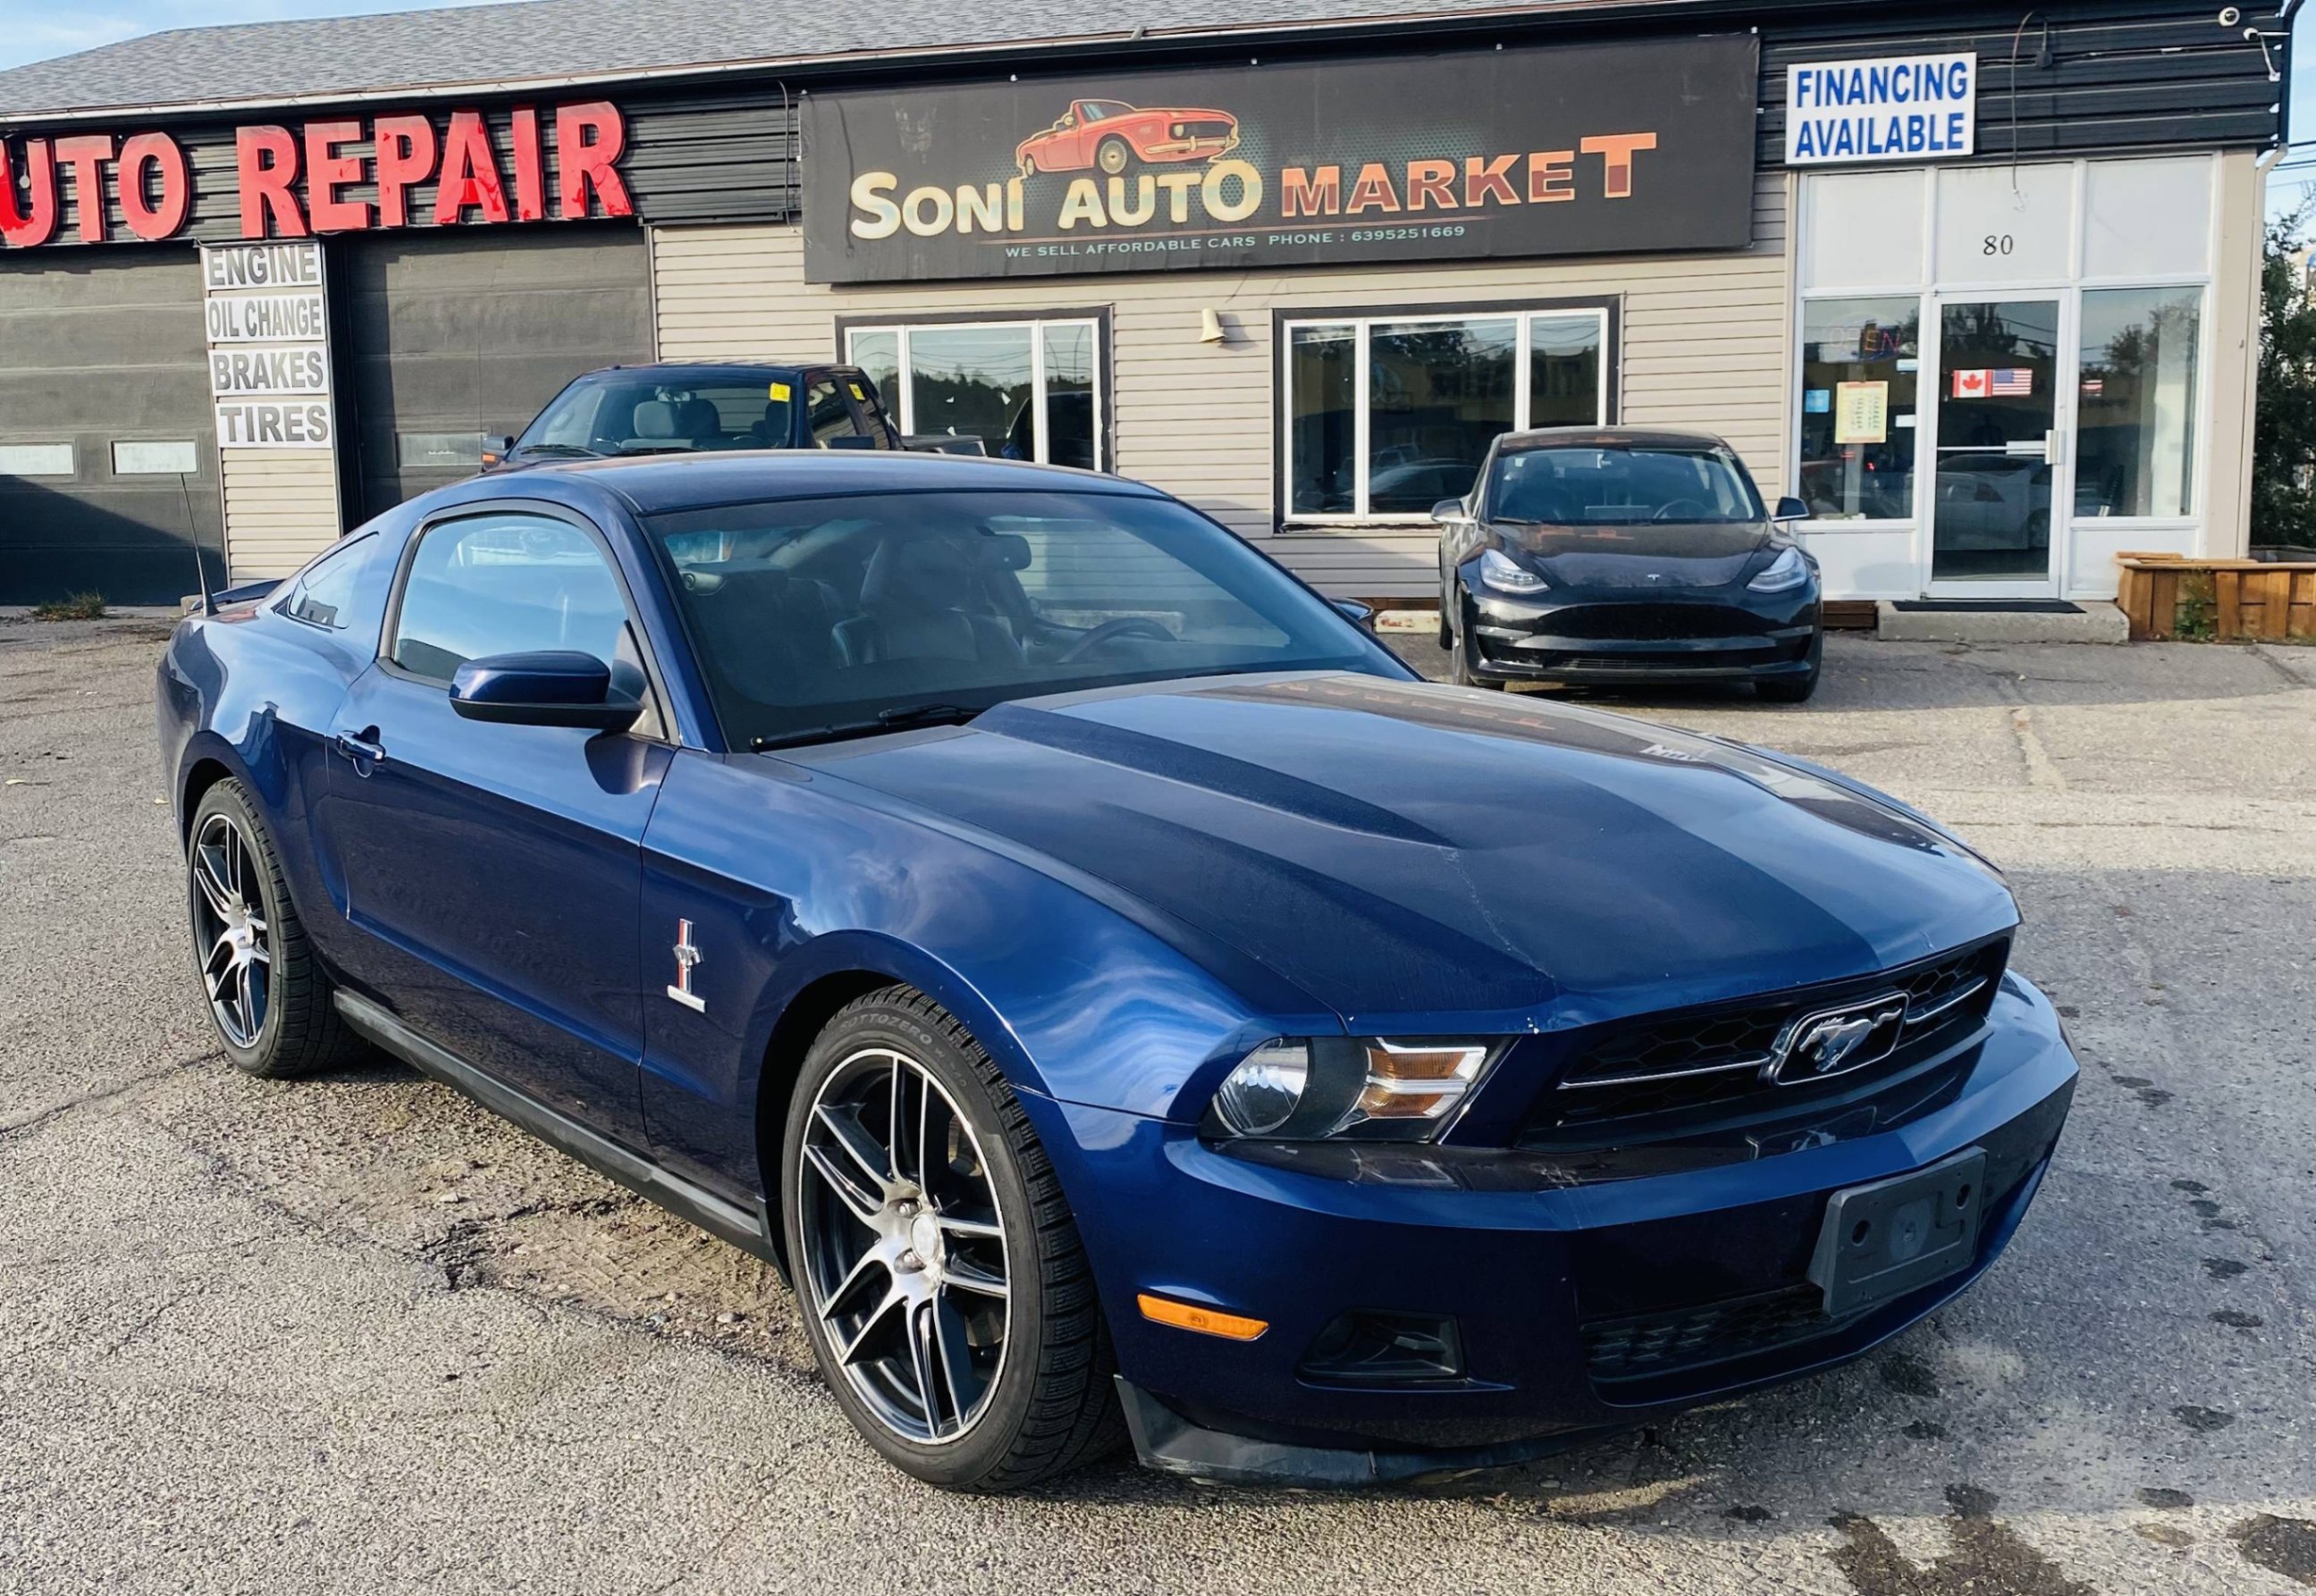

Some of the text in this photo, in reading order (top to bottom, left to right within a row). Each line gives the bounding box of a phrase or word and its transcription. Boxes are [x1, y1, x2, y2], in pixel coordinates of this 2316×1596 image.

[1797, 62, 1966, 107] FINANCING
[1796, 113, 1965, 156] AVAILABLE
[235, 100, 633, 239] REPAIR
[850, 132, 1656, 239] SONI AUTO MARKET
[1006, 247, 1032, 257] WE
[1037, 245, 1080, 256] SELL
[1085, 239, 1201, 255] AFFORDABLE
[1208, 236, 1256, 248] CARS
[1268, 232, 1333, 246] PHONE
[1351, 225, 1466, 241] 6395251669
[1983, 234, 2013, 256] 80
[207, 244, 317, 286] ENGINE
[208, 298, 322, 338] OIL CHANGE
[213, 350, 324, 391] BRAKES
[219, 405, 329, 442] TIRES
[840, 1013, 932, 1045] SOTTOZERO
